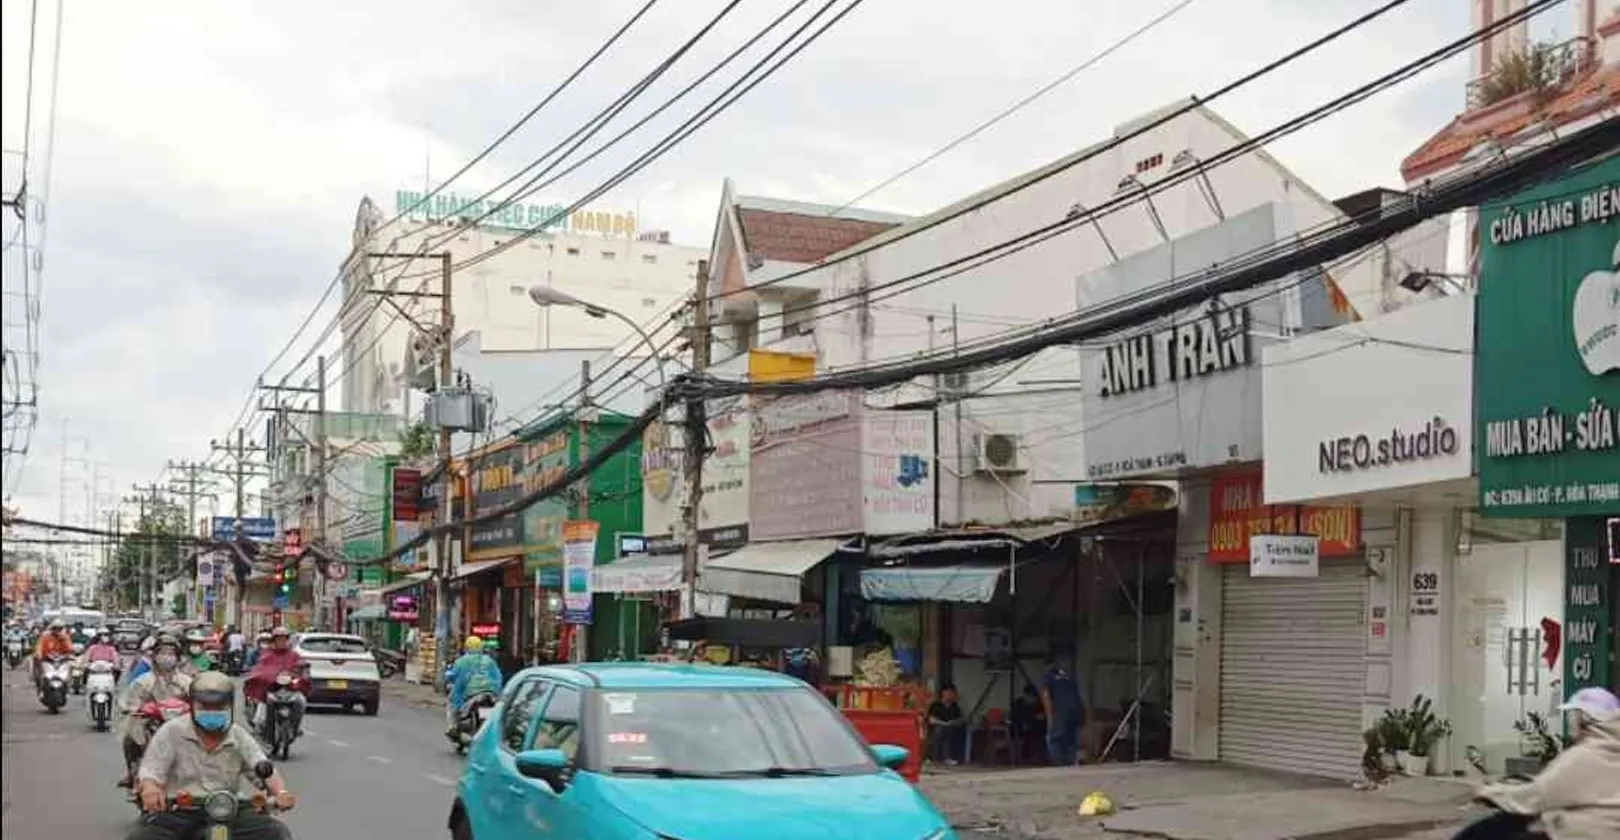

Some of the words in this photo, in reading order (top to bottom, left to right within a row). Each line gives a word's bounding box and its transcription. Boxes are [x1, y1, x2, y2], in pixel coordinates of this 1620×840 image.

[570, 208, 611, 231] NAM
[1491, 206, 1522, 244] CỬA
[1526, 201, 1574, 235] HÀNG
[1581, 185, 1620, 224] ĐIỆN
[1098, 335, 1152, 396] ANH
[1487, 420, 1522, 457] MUA
[1527, 406, 1562, 454] BÁN
[1577, 396, 1613, 450] SỬA
[1319, 414, 1457, 473] NEO.studio
[1573, 548, 1599, 568] THU
[1414, 573, 1437, 590] 639
[1570, 584, 1599, 606] MUA
[1567, 616, 1597, 643] MÁY
